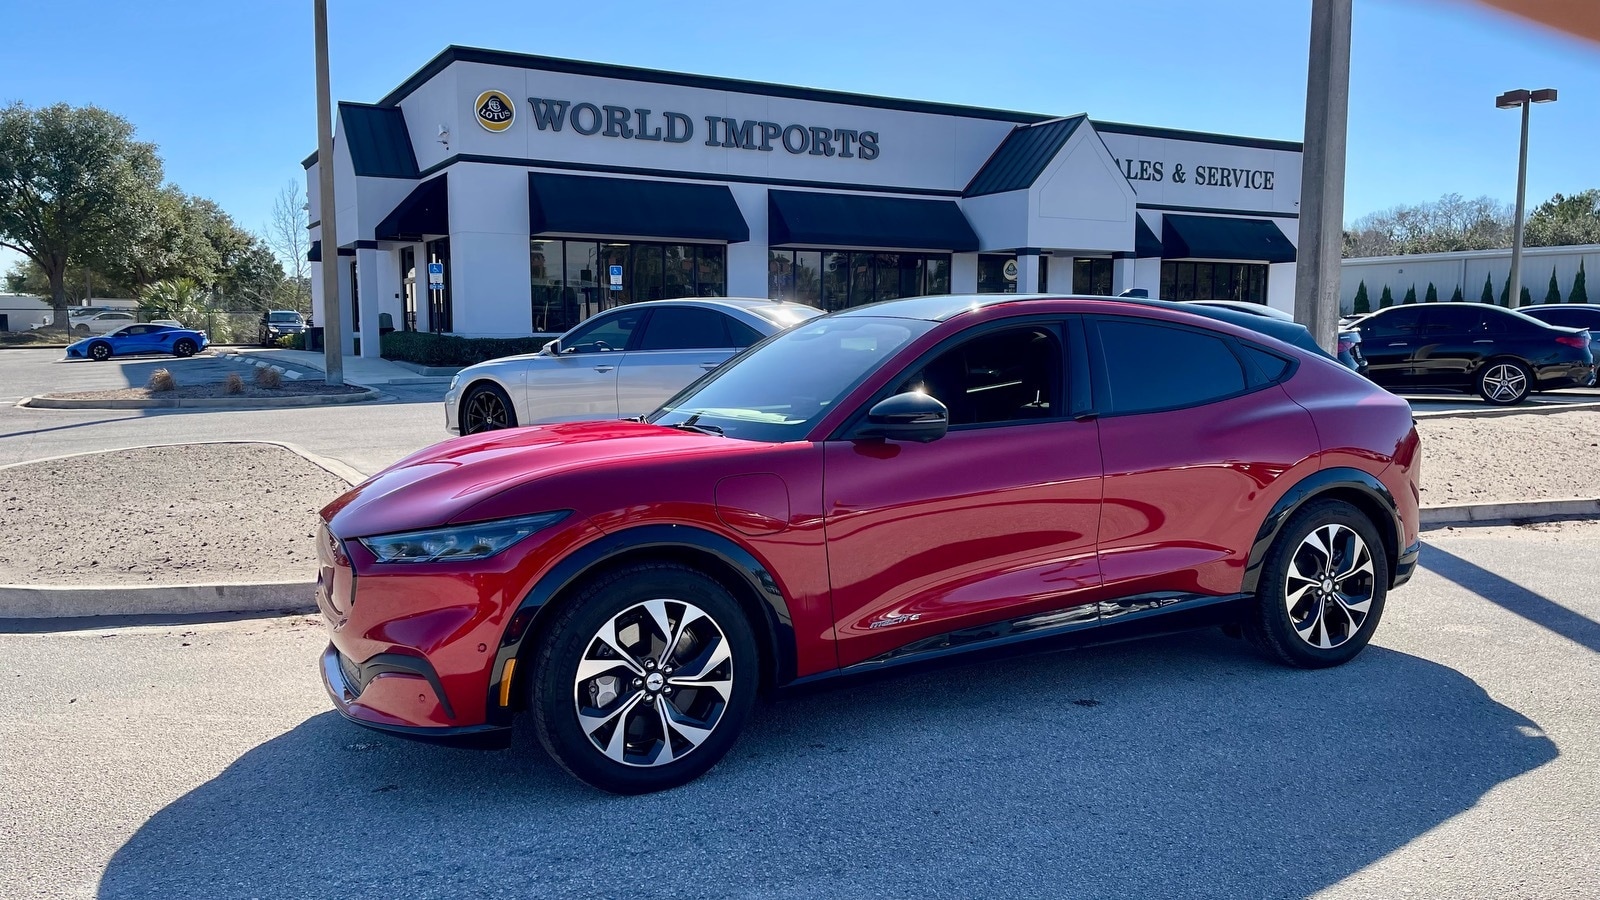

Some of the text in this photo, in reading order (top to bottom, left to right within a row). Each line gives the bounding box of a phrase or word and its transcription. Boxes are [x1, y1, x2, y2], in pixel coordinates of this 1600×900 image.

[480, 108, 511, 120] LOTUS
[528, 97, 880, 161] WORLD IMPORTS
[1115, 157, 1275, 191] LES & SERVICE
